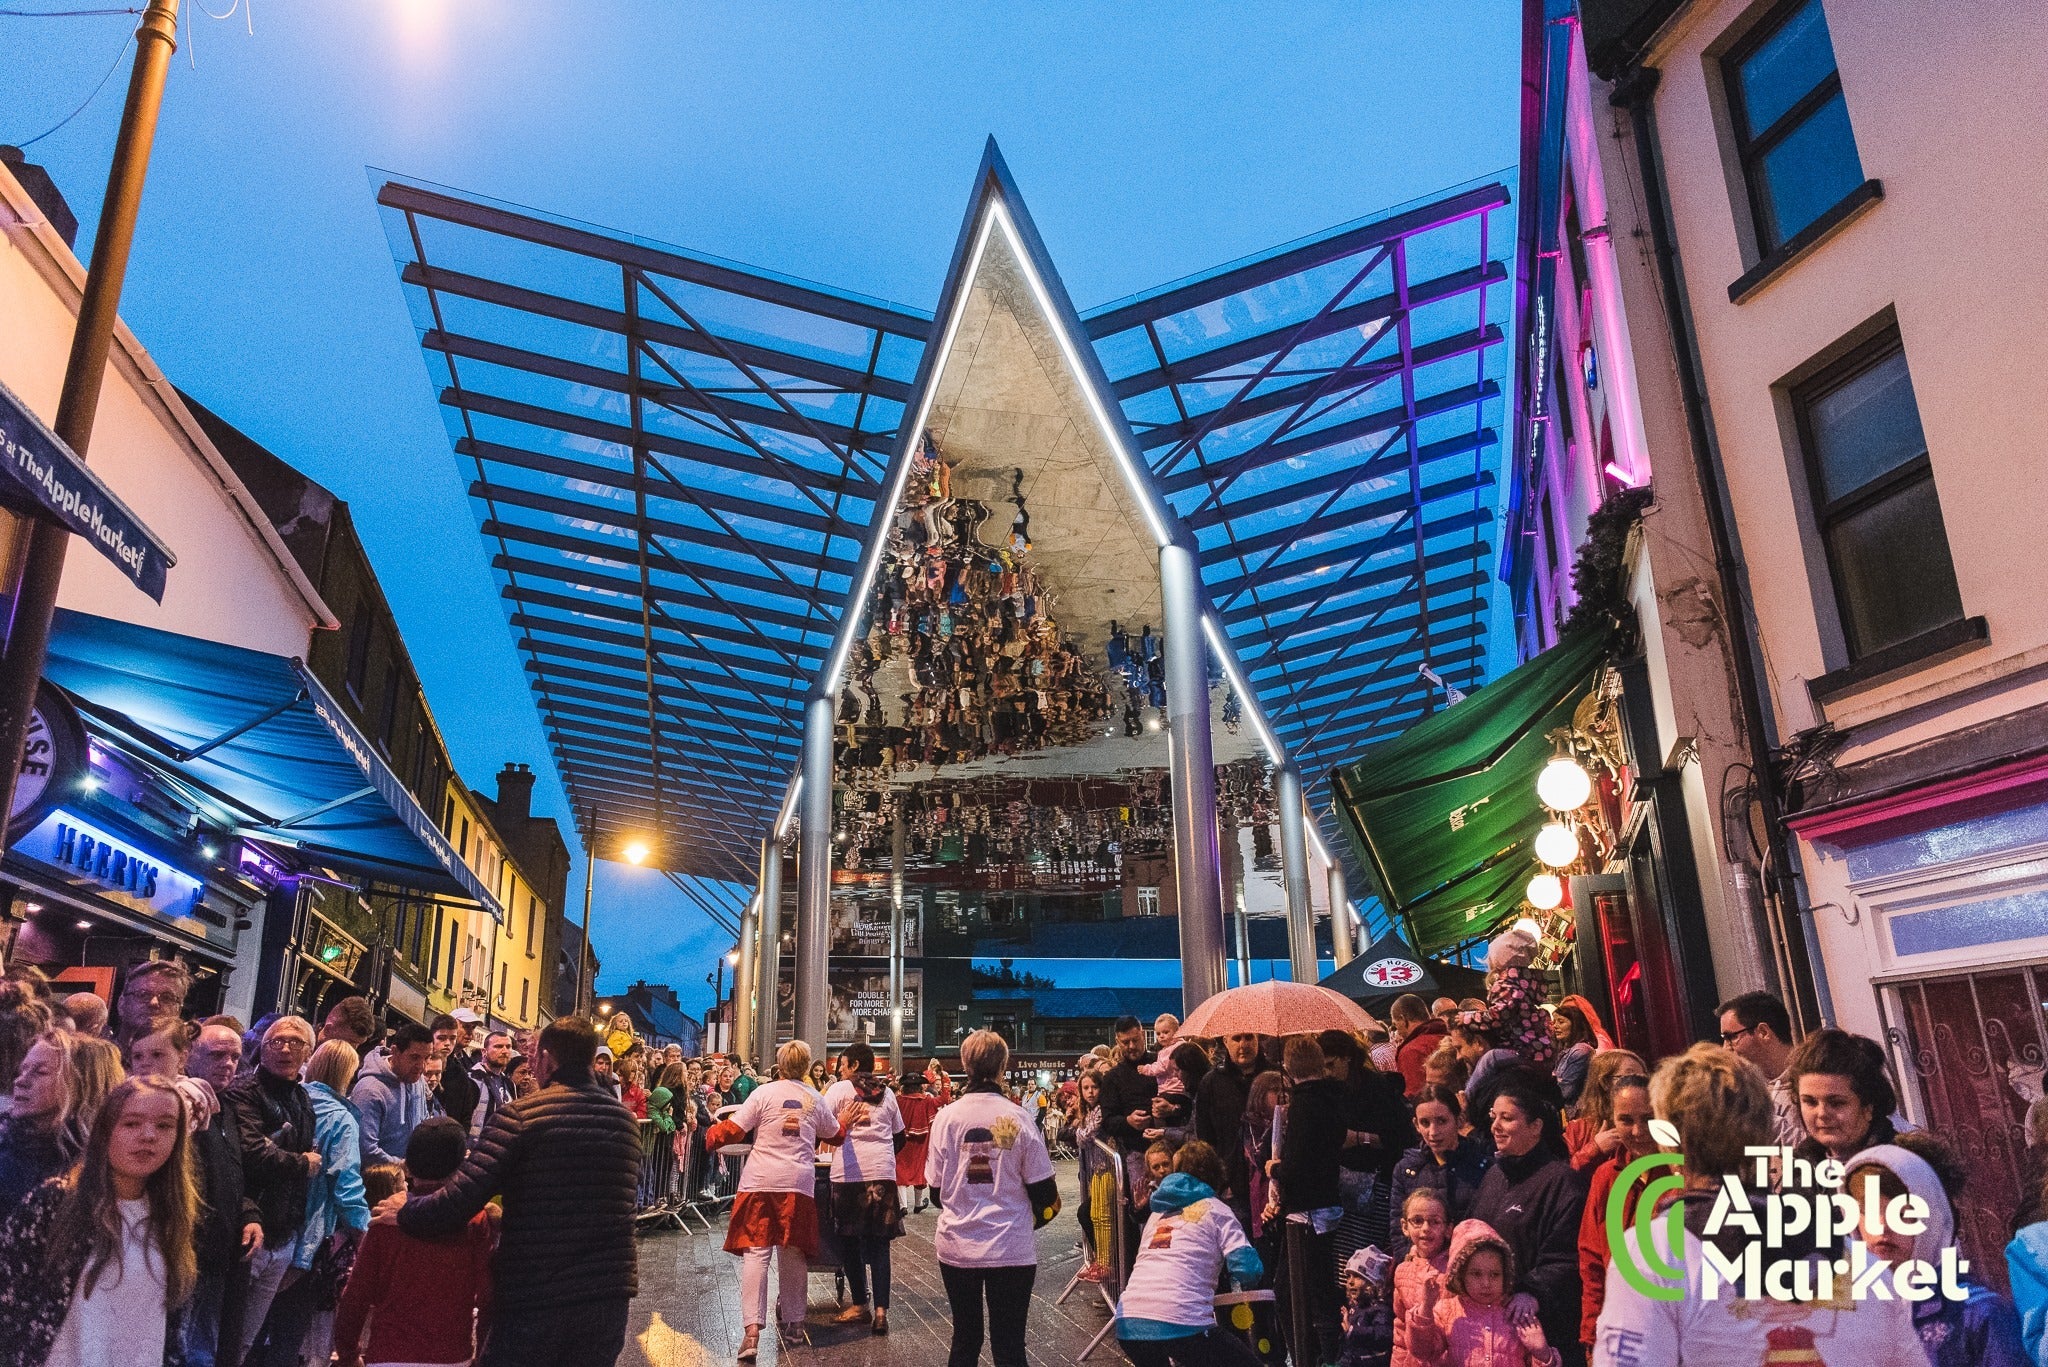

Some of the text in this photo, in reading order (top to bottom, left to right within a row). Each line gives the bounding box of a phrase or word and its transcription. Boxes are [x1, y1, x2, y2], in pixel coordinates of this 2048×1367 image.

[6, 441, 17, 458] at
[18, 446, 44, 480] The
[43, 465, 91, 523] Apple
[90, 505, 139, 569] Market
[1377, 967, 1413, 981] 13
[857, 991, 884, 999] DOUBLE
[849, 999, 863, 1008] FOR
[864, 999, 884, 1008] MORE
[907, 999, 913, 1008] &
[852, 1008, 872, 1016] MORE
